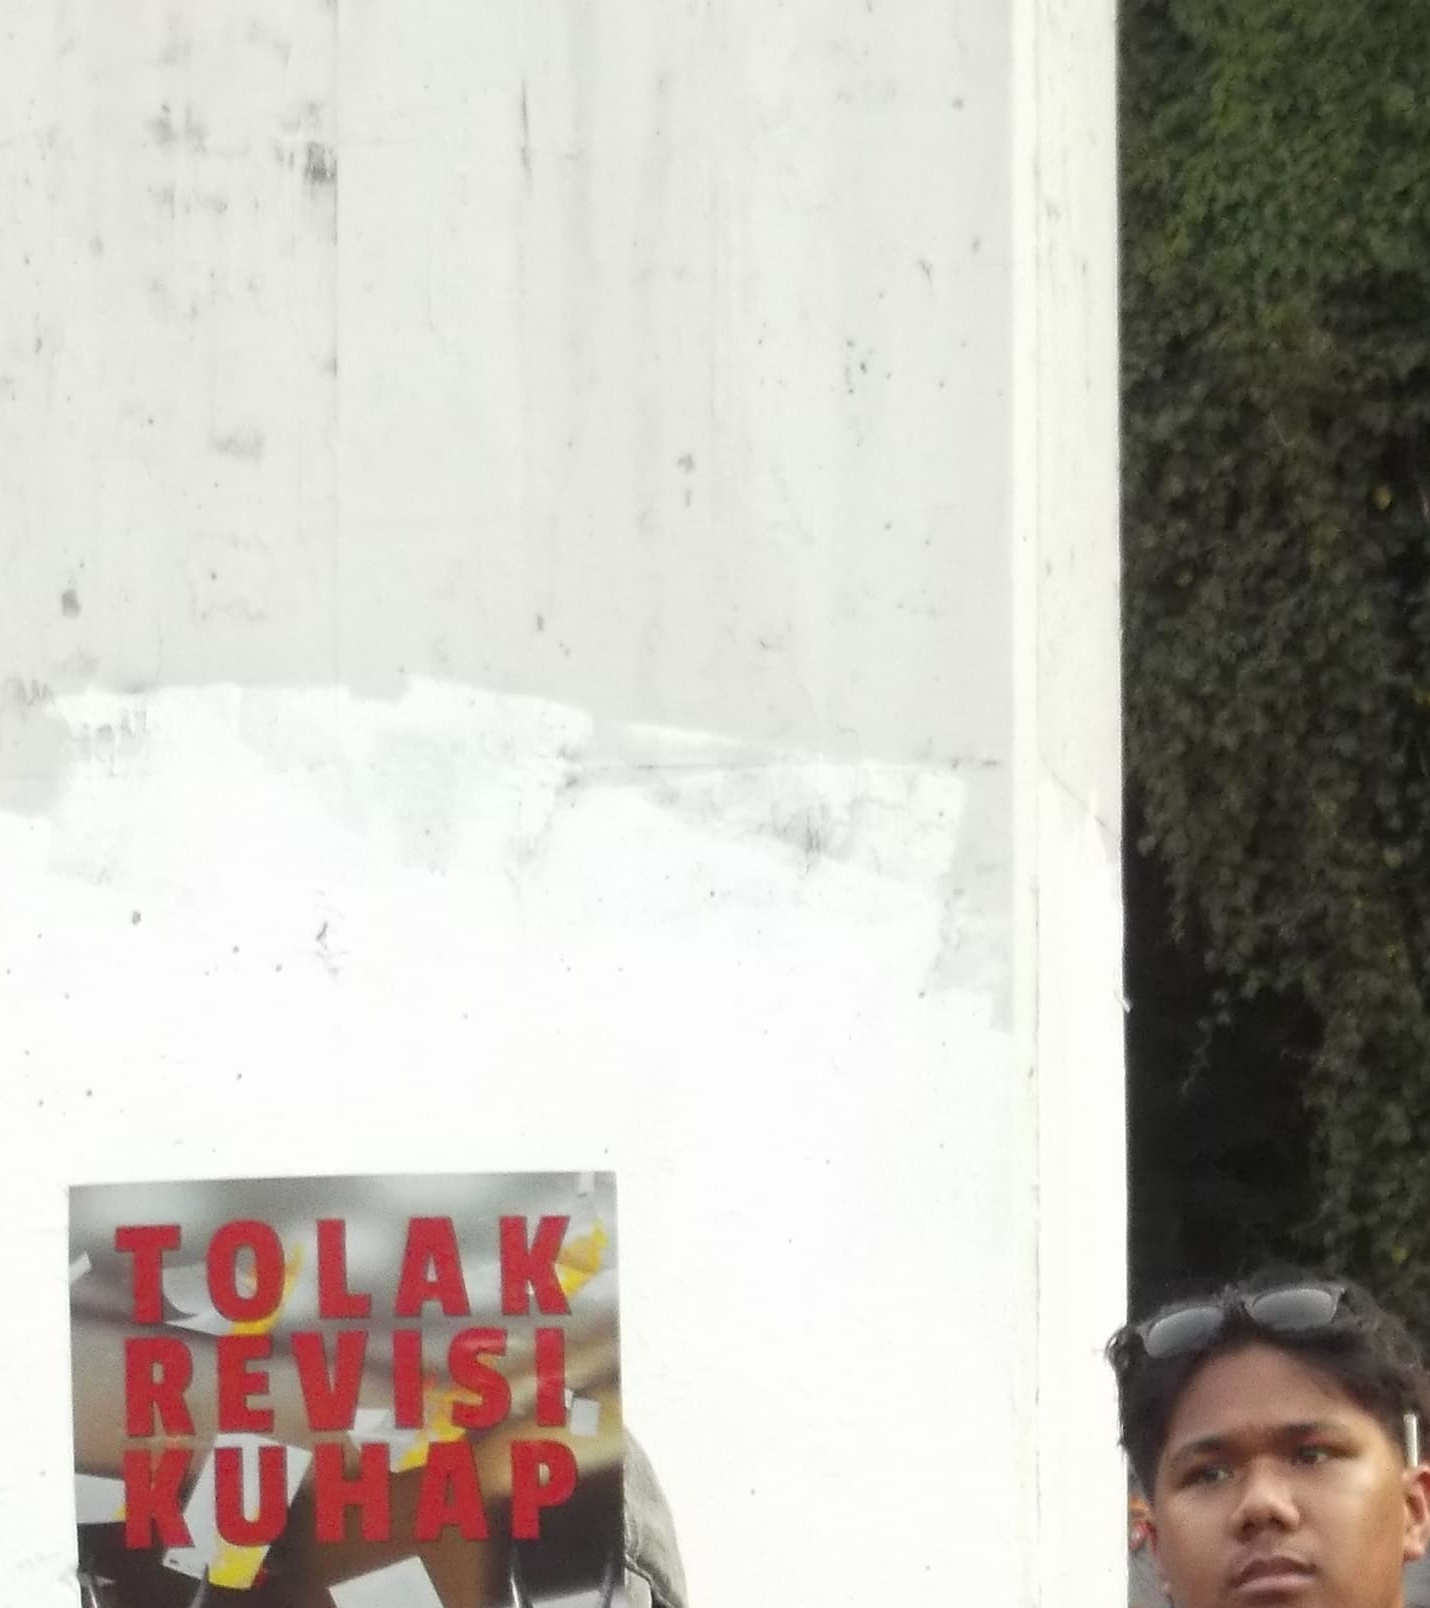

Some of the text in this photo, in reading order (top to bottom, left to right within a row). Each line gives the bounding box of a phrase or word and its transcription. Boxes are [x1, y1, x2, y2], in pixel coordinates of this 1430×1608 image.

[114, 1215, 569, 1325] TOLAK
[123, 1327, 568, 1438] REVISI
[121, 1437, 579, 1549] KUHAP
